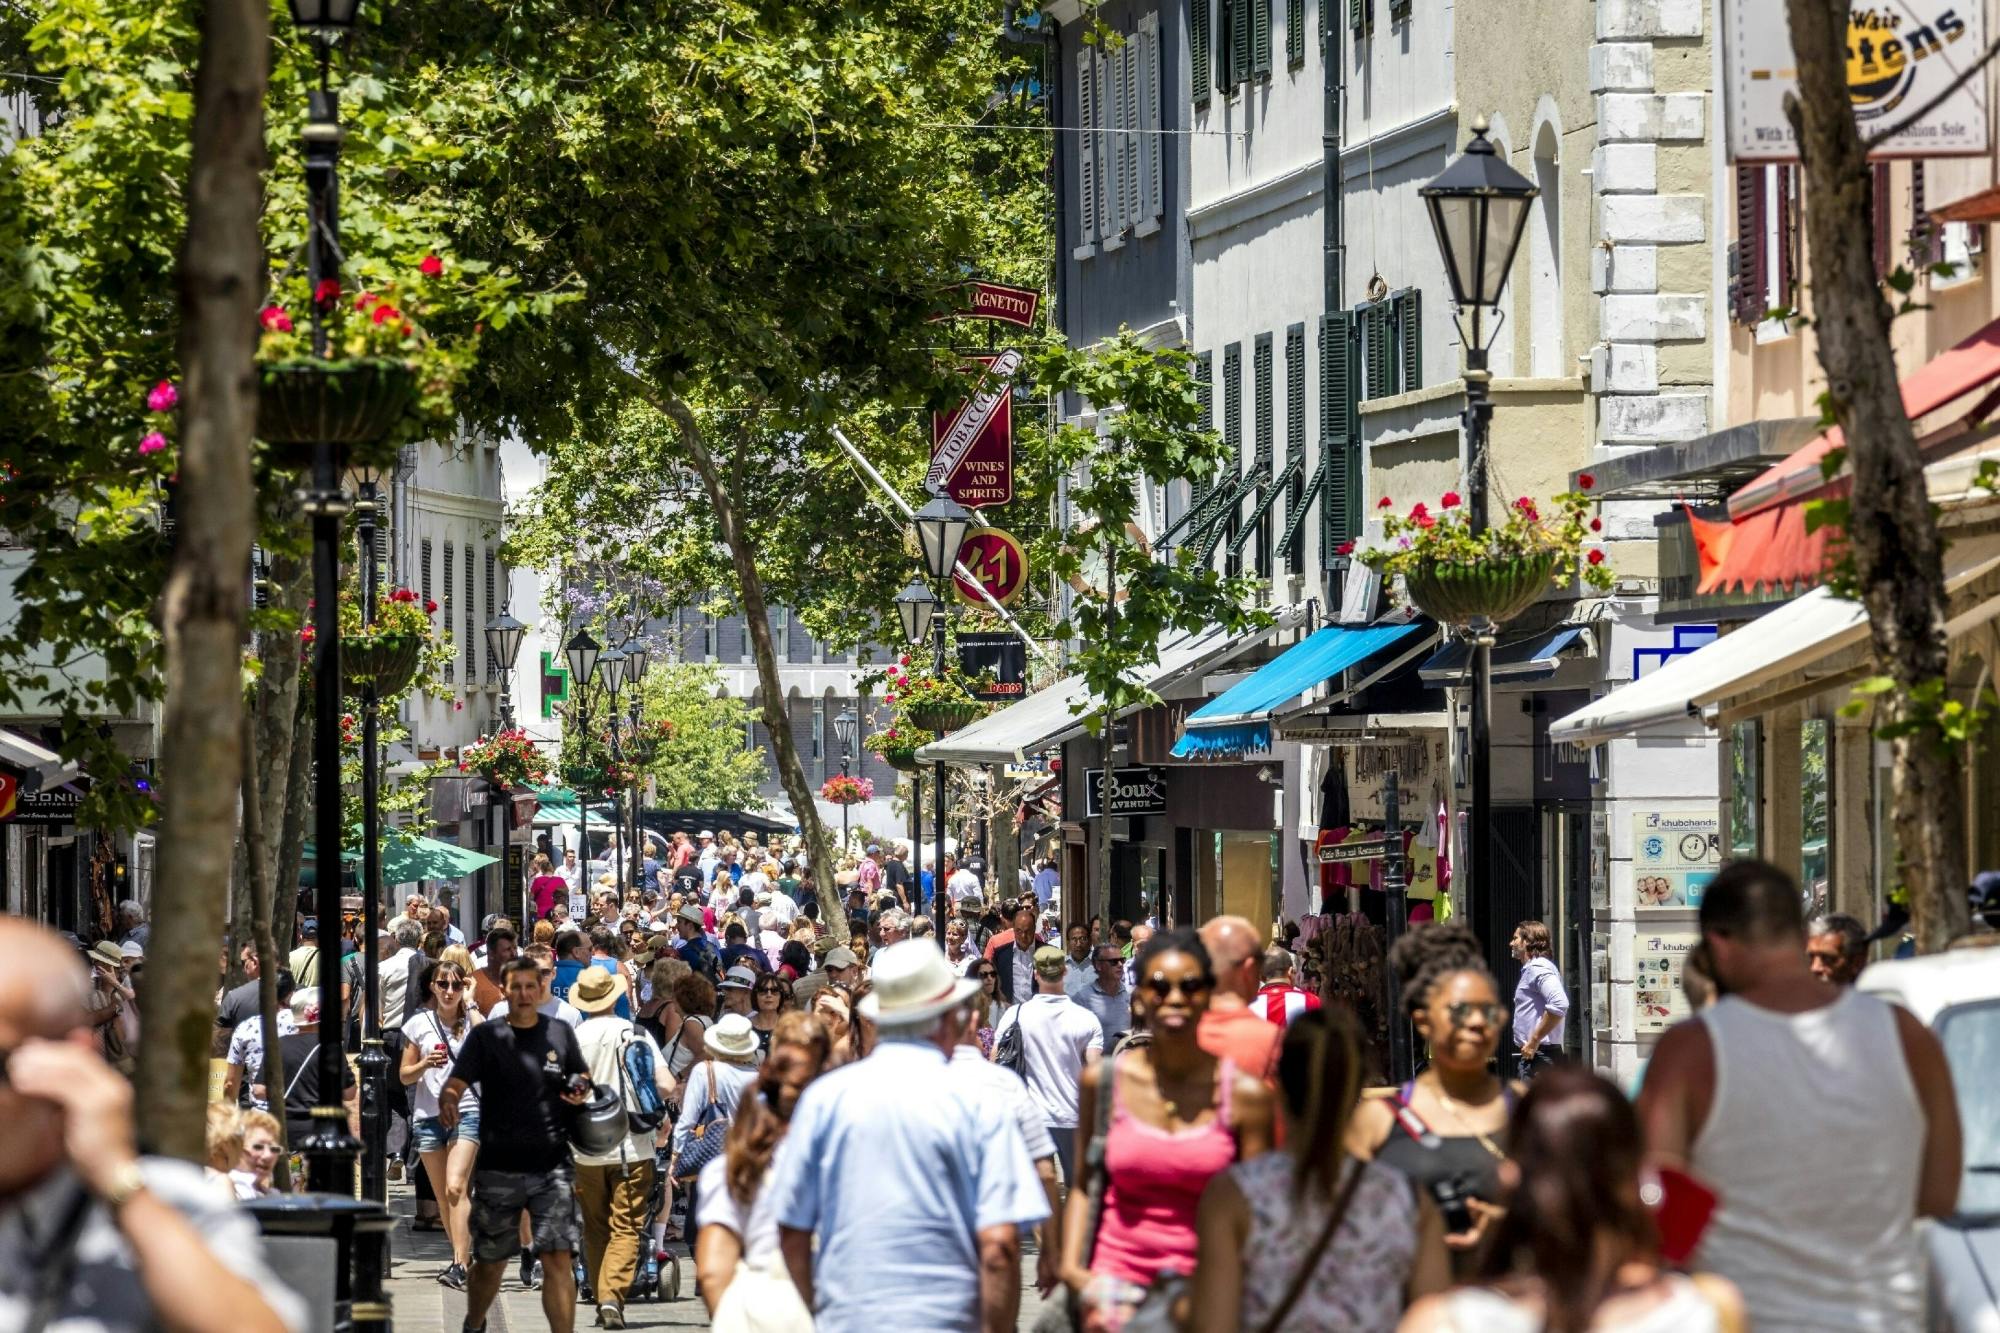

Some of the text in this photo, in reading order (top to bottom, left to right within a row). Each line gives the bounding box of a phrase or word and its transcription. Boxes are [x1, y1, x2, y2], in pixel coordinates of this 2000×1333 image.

[1756, 127, 1783, 142] With
[965, 461, 1004, 472] WINES
[971, 475, 997, 485] AND
[958, 488, 1005, 499] SPIRITS
[965, 545, 1008, 588] 41
[1111, 801, 1150, 809] AVENUE
[1662, 819, 1717, 827] khubchands
[684, 878, 692, 889] 9
[570, 905, 585, 913] £15
